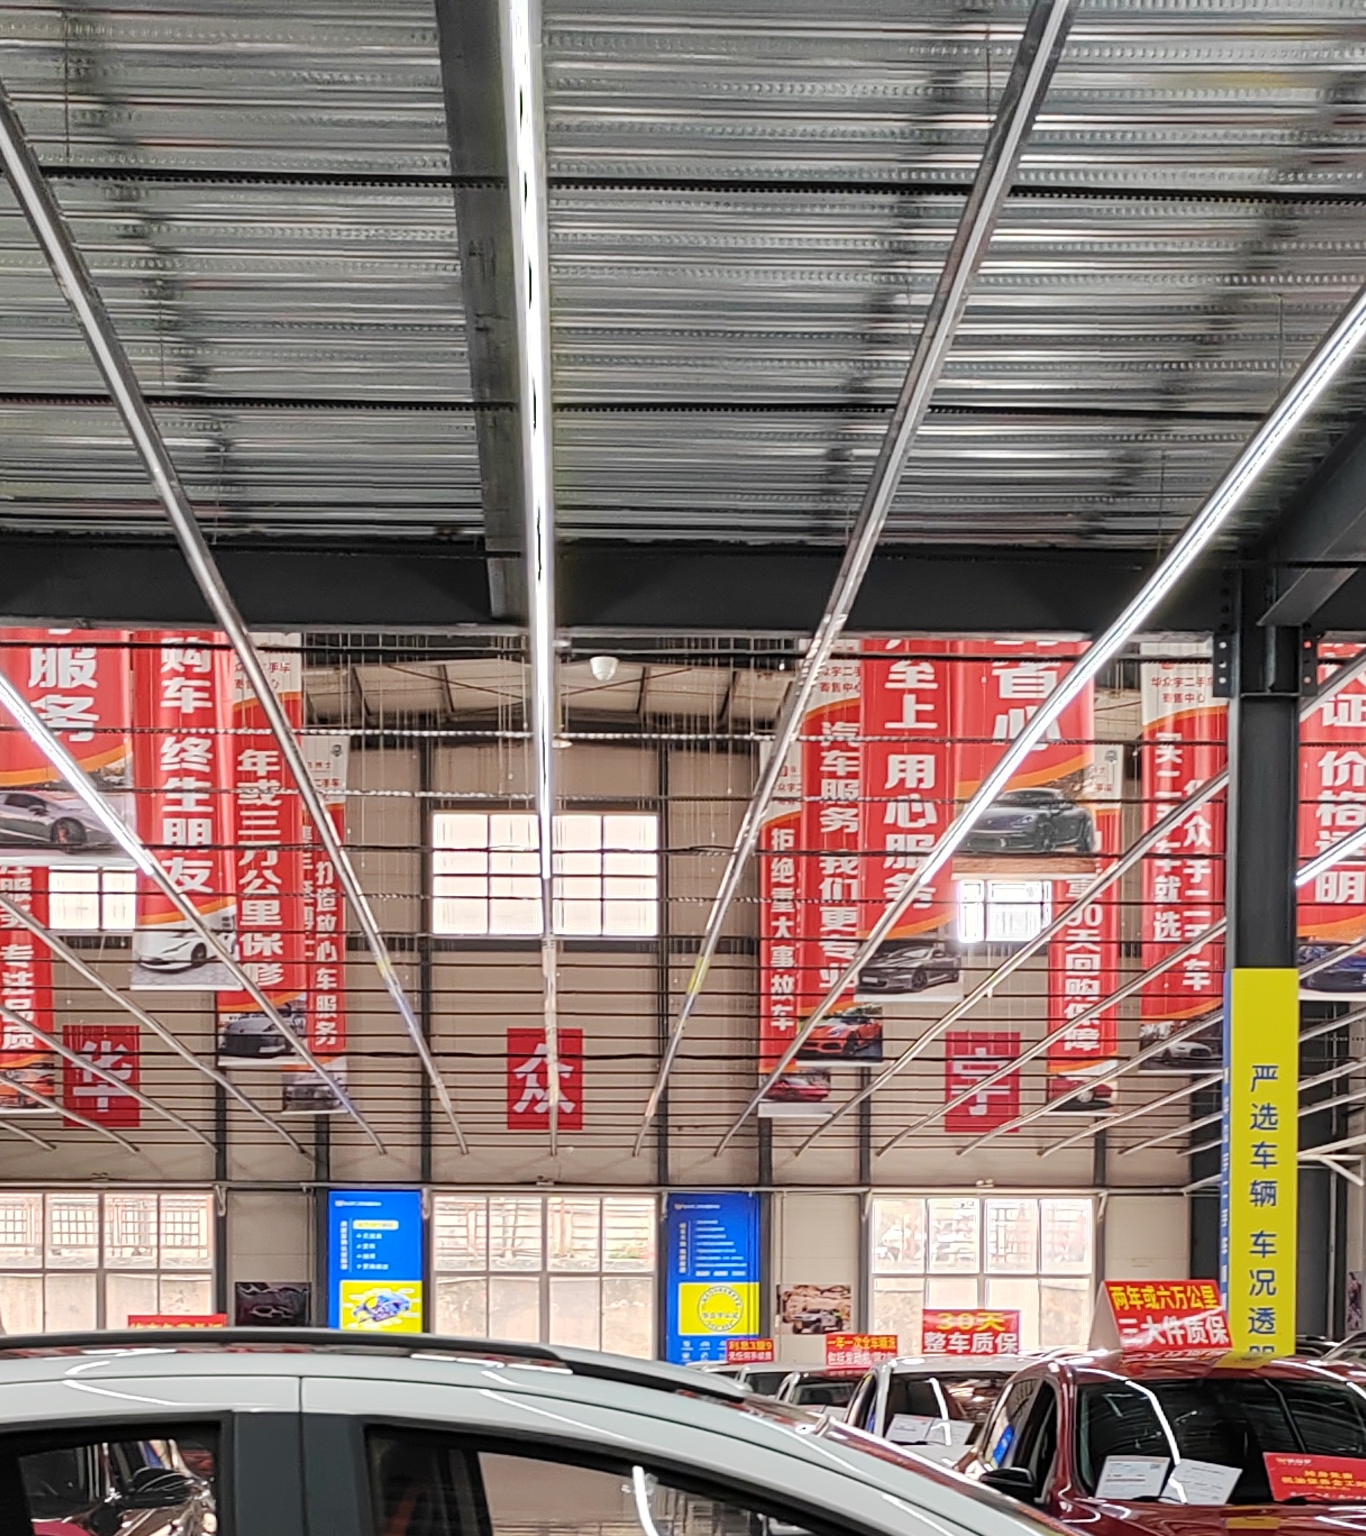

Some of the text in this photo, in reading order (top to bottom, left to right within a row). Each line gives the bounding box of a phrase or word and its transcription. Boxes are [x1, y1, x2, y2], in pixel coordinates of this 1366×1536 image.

[27, 628, 101, 743] 服务
[885, 640, 938, 729] 至上
[992, 640, 1061, 751] 省心
[161, 637, 213, 893] 购车 终生朋友
[512, 1043, 576, 1113] 众
[1250, 1065, 1279, 1207] 严选车辆
[937, 1312, 1007, 1332] 30天
[1109, 1285, 1221, 1311] 两年或六万公里
[1119, 1315, 1230, 1345] 三大件质保
[924, 1333, 1019, 1354] 整车质保
